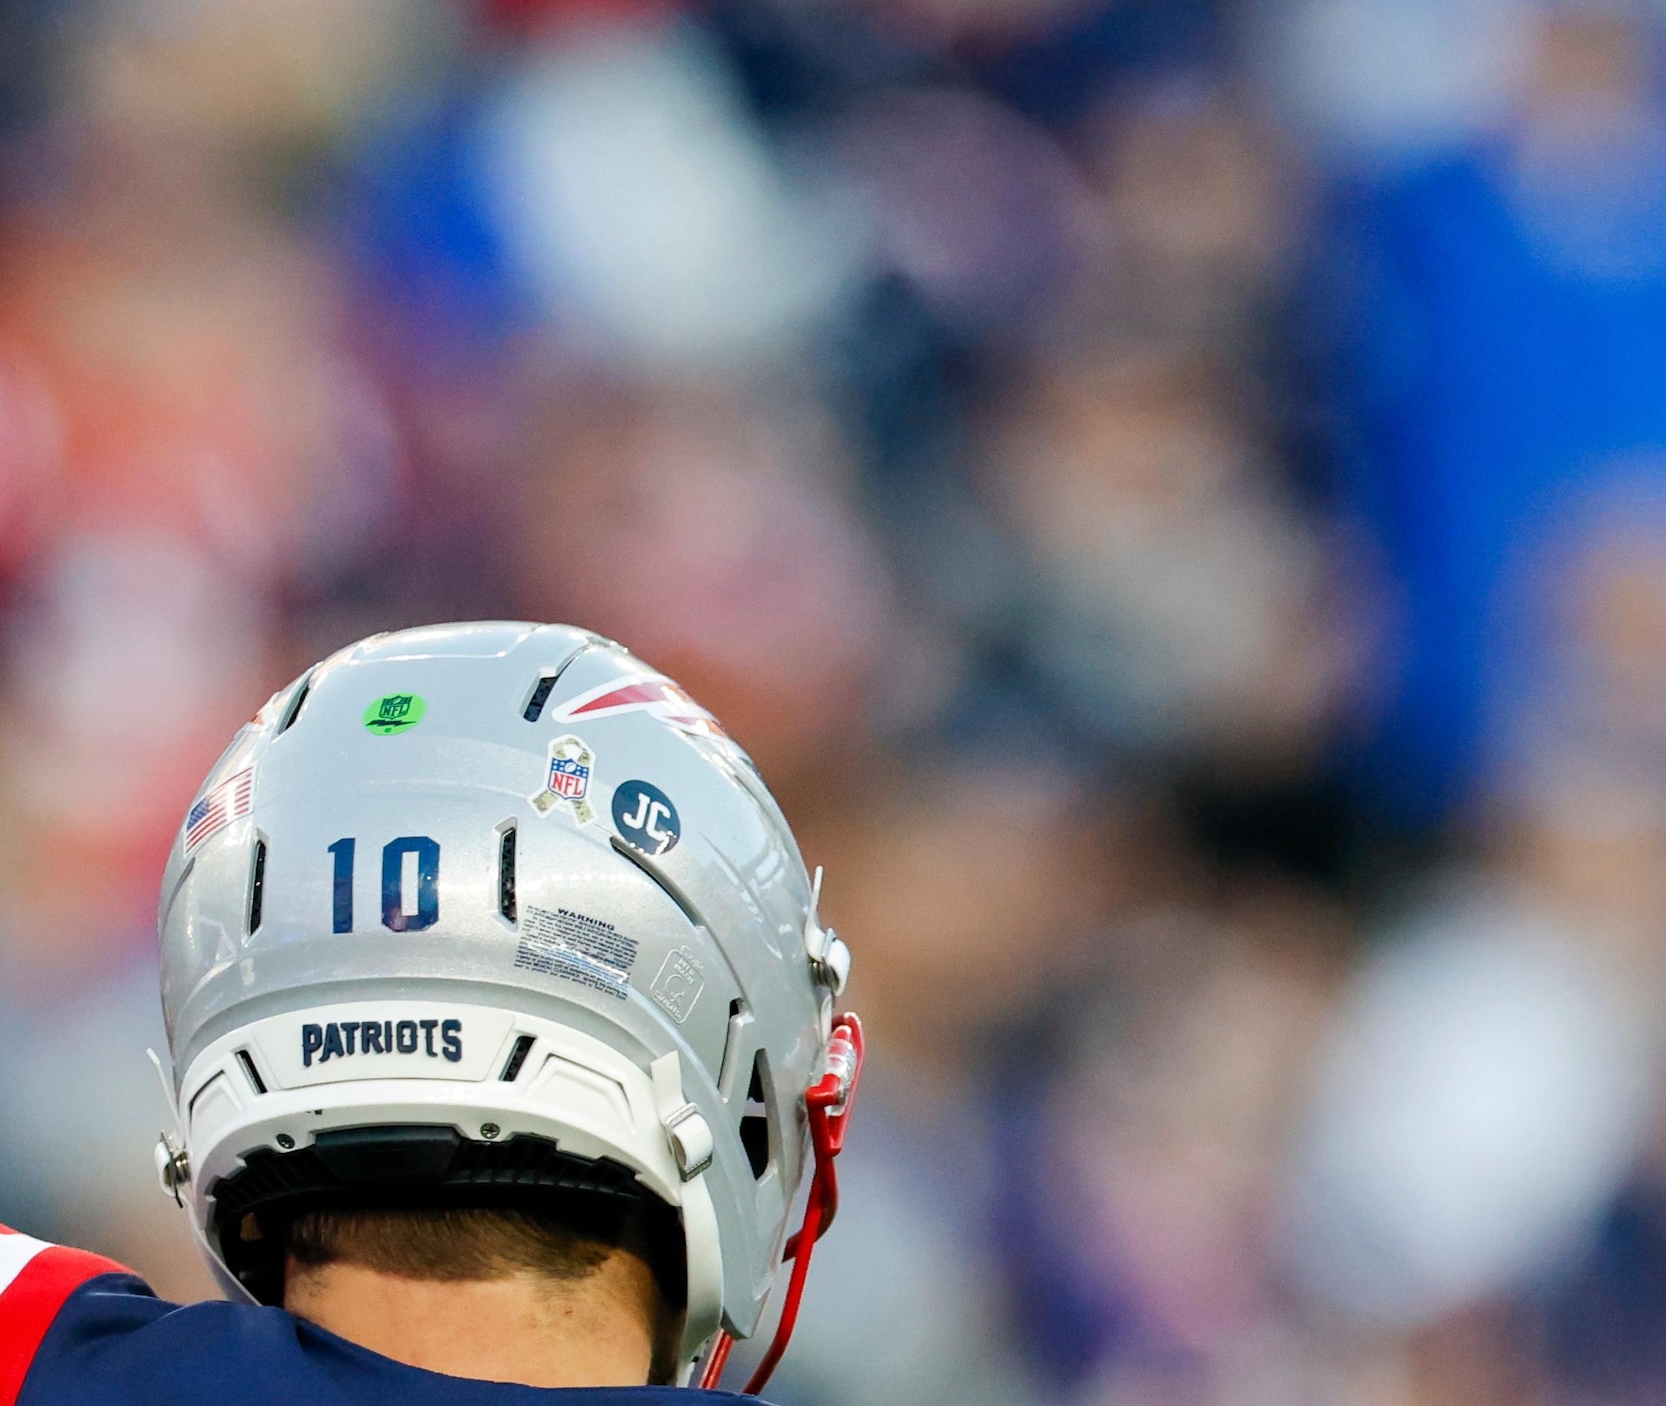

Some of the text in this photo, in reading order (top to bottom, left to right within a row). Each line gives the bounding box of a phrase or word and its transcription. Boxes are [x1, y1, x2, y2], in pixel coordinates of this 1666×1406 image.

[552, 772, 583, 796] NFL
[622, 792, 671, 842] JC
[327, 836, 440, 934] 10
[558, 908, 615, 931] WARNING
[302, 1018, 463, 1068] PATRIOTS
